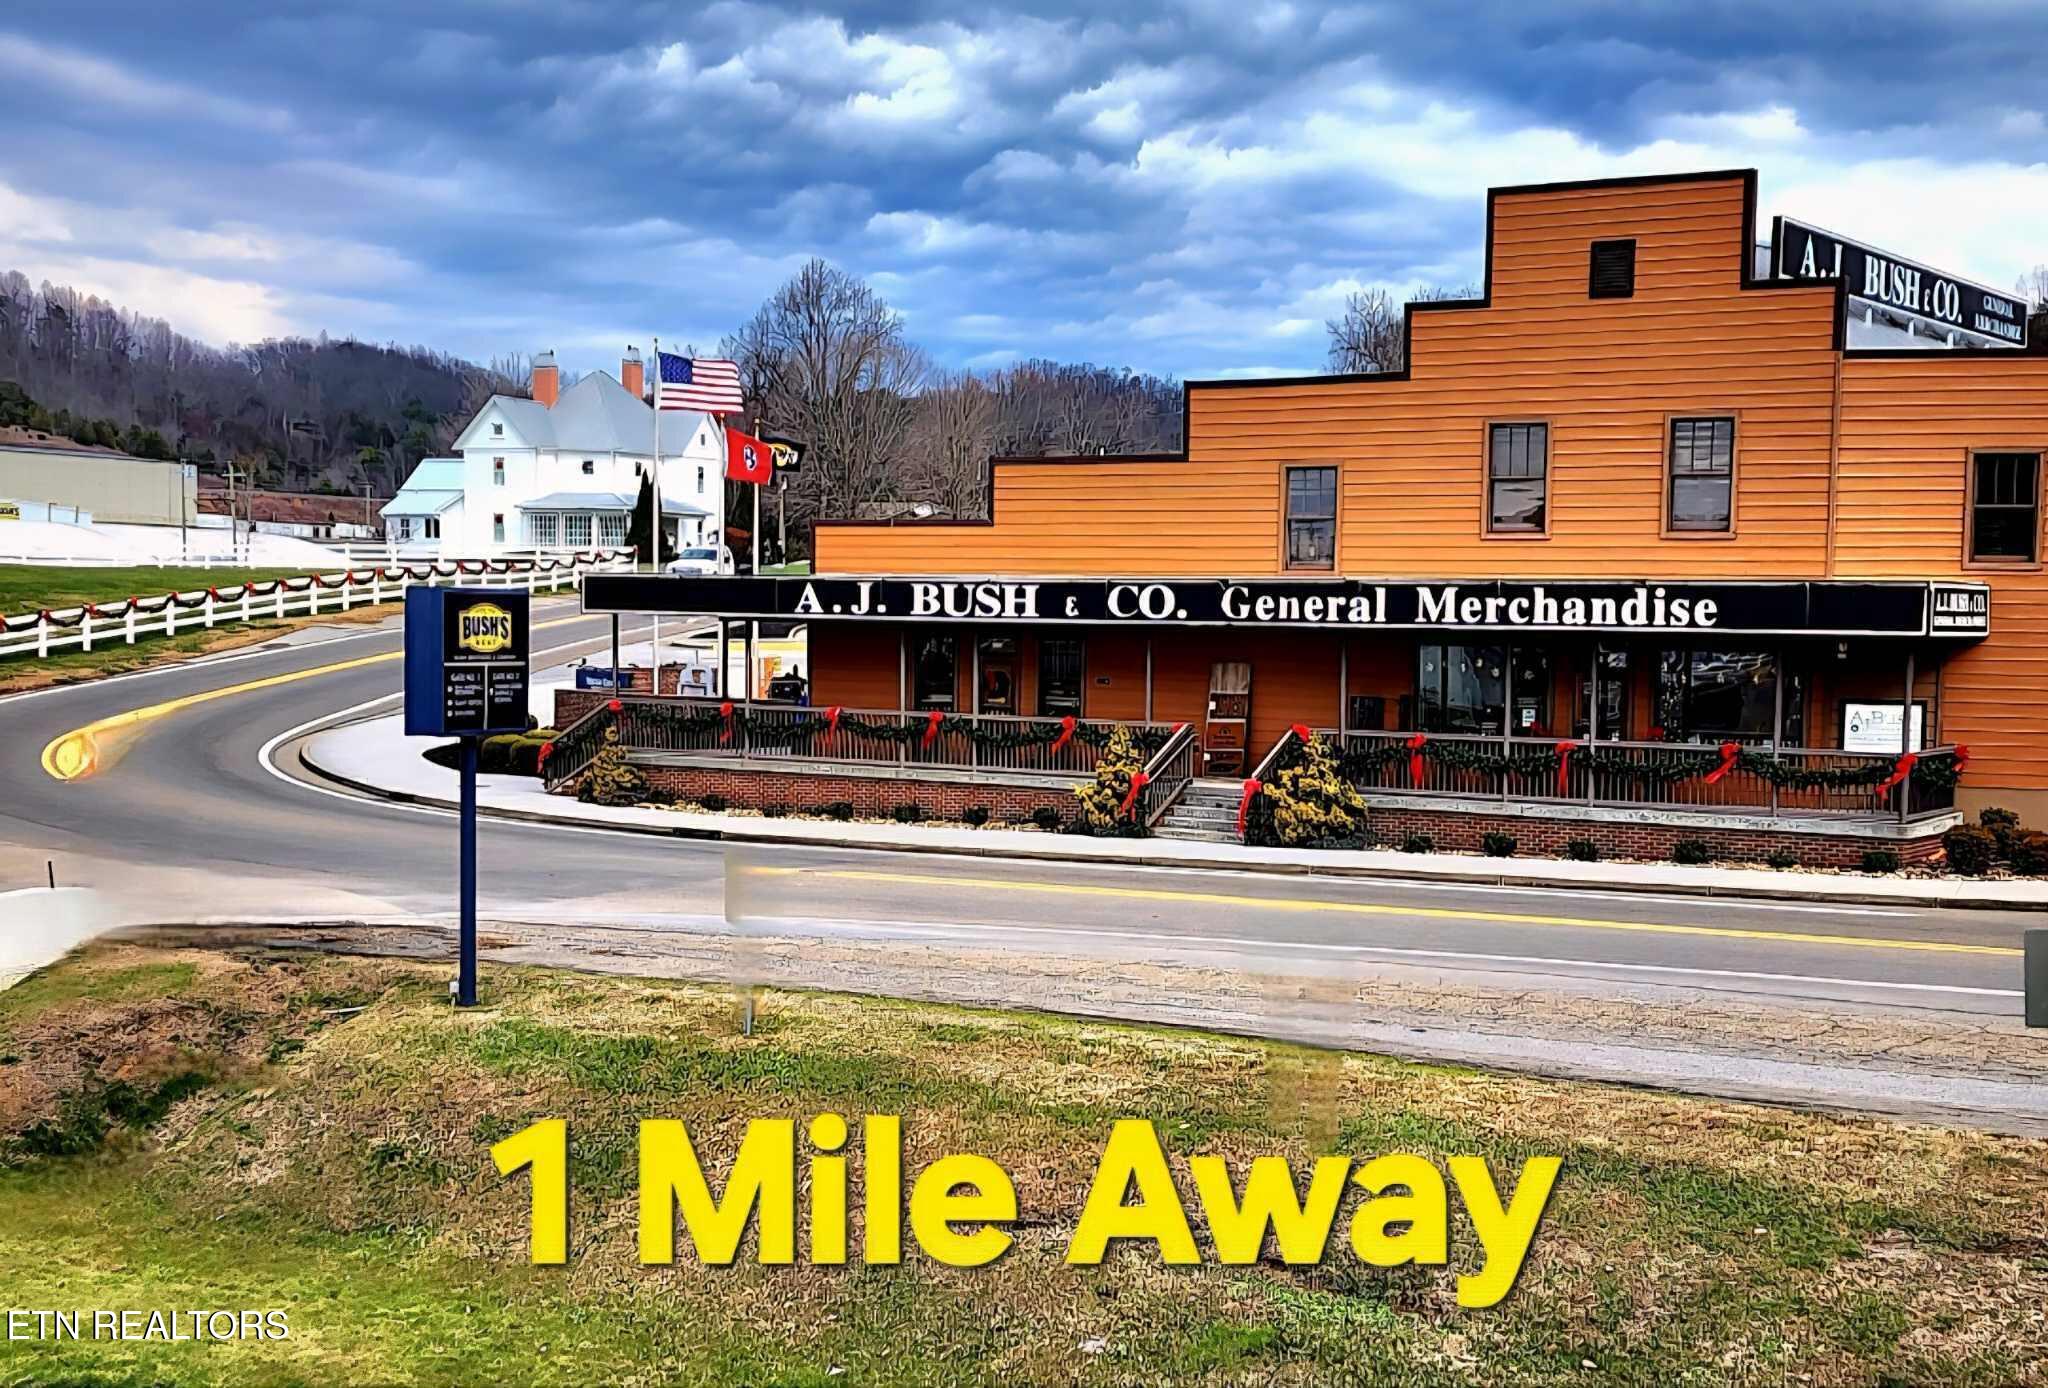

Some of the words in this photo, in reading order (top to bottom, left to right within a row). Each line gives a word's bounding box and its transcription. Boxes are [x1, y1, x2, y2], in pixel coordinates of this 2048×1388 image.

[1864, 254, 1922, 310] BUSH
[1933, 279, 1963, 323] CO.
[795, 582, 887, 615] A.J.
[910, 583, 1040, 617] BUSH
[1065, 596, 1080, 617] &
[1107, 584, 1188, 619] CO.
[1220, 585, 1387, 621] General
[1414, 586, 1719, 627] Merchandise
[463, 615, 509, 640] BUSH'S
